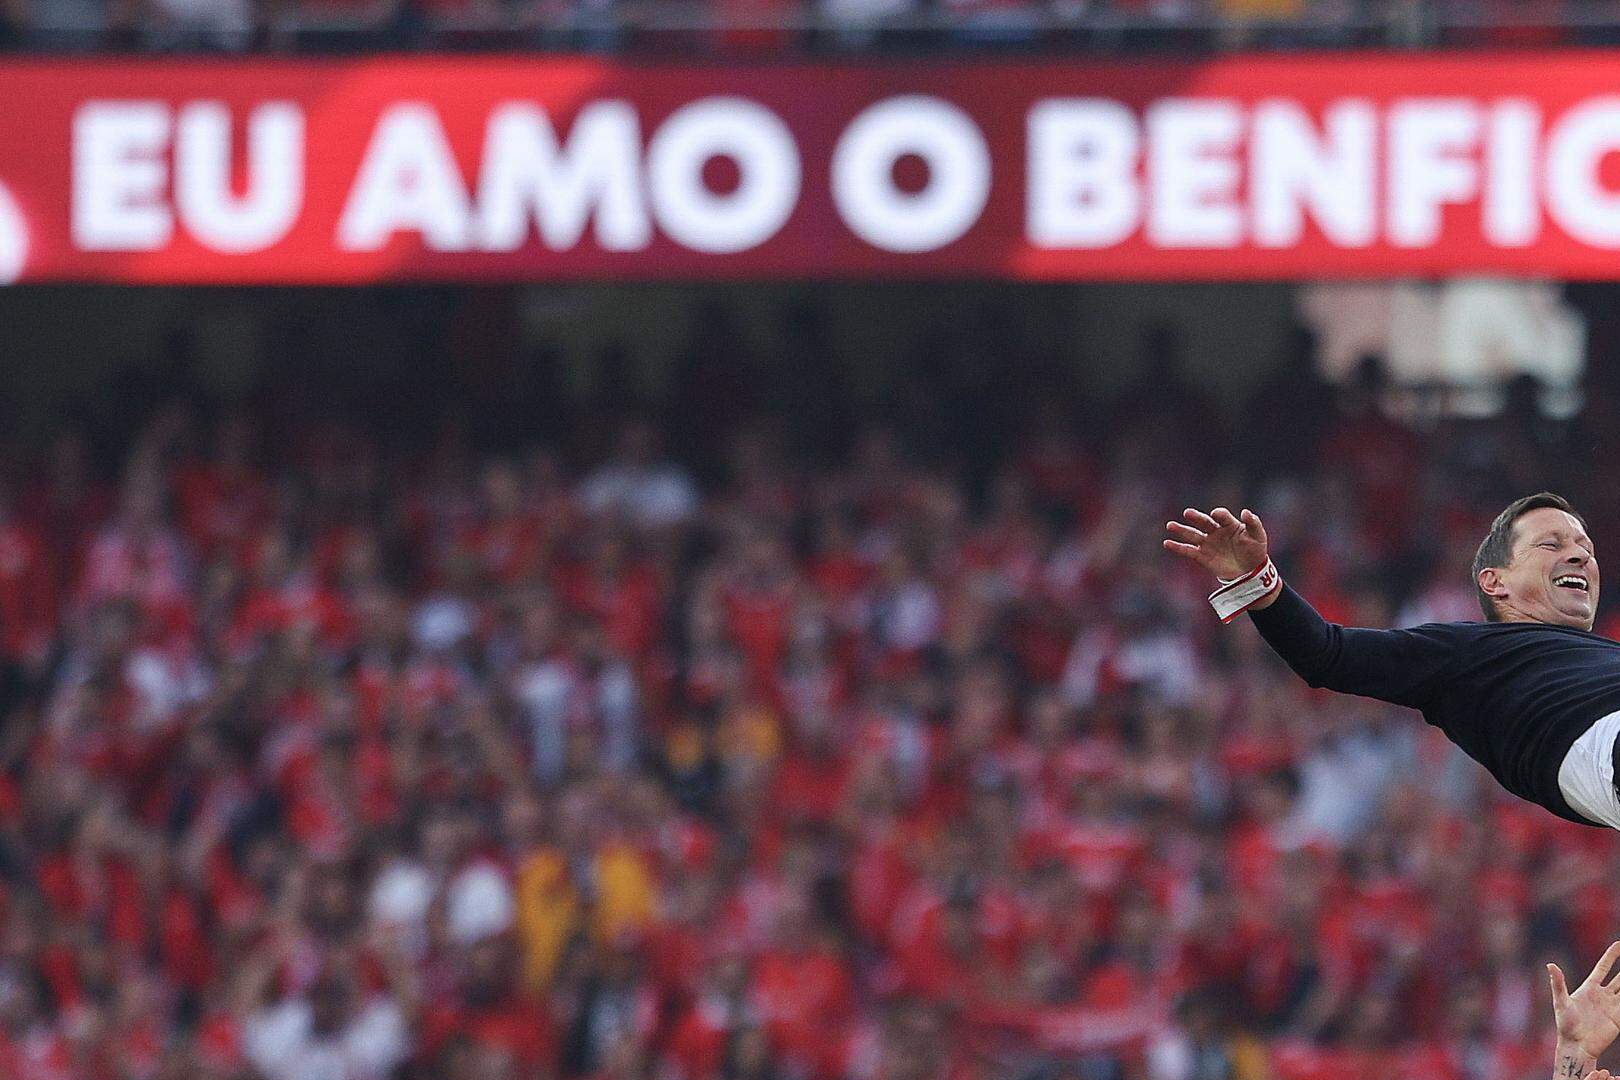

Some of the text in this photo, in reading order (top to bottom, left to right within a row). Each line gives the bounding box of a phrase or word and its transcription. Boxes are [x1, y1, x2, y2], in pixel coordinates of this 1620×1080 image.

[72, 99, 305, 253] EU
[336, 94, 800, 255] AMO
[829, 94, 992, 254] O
